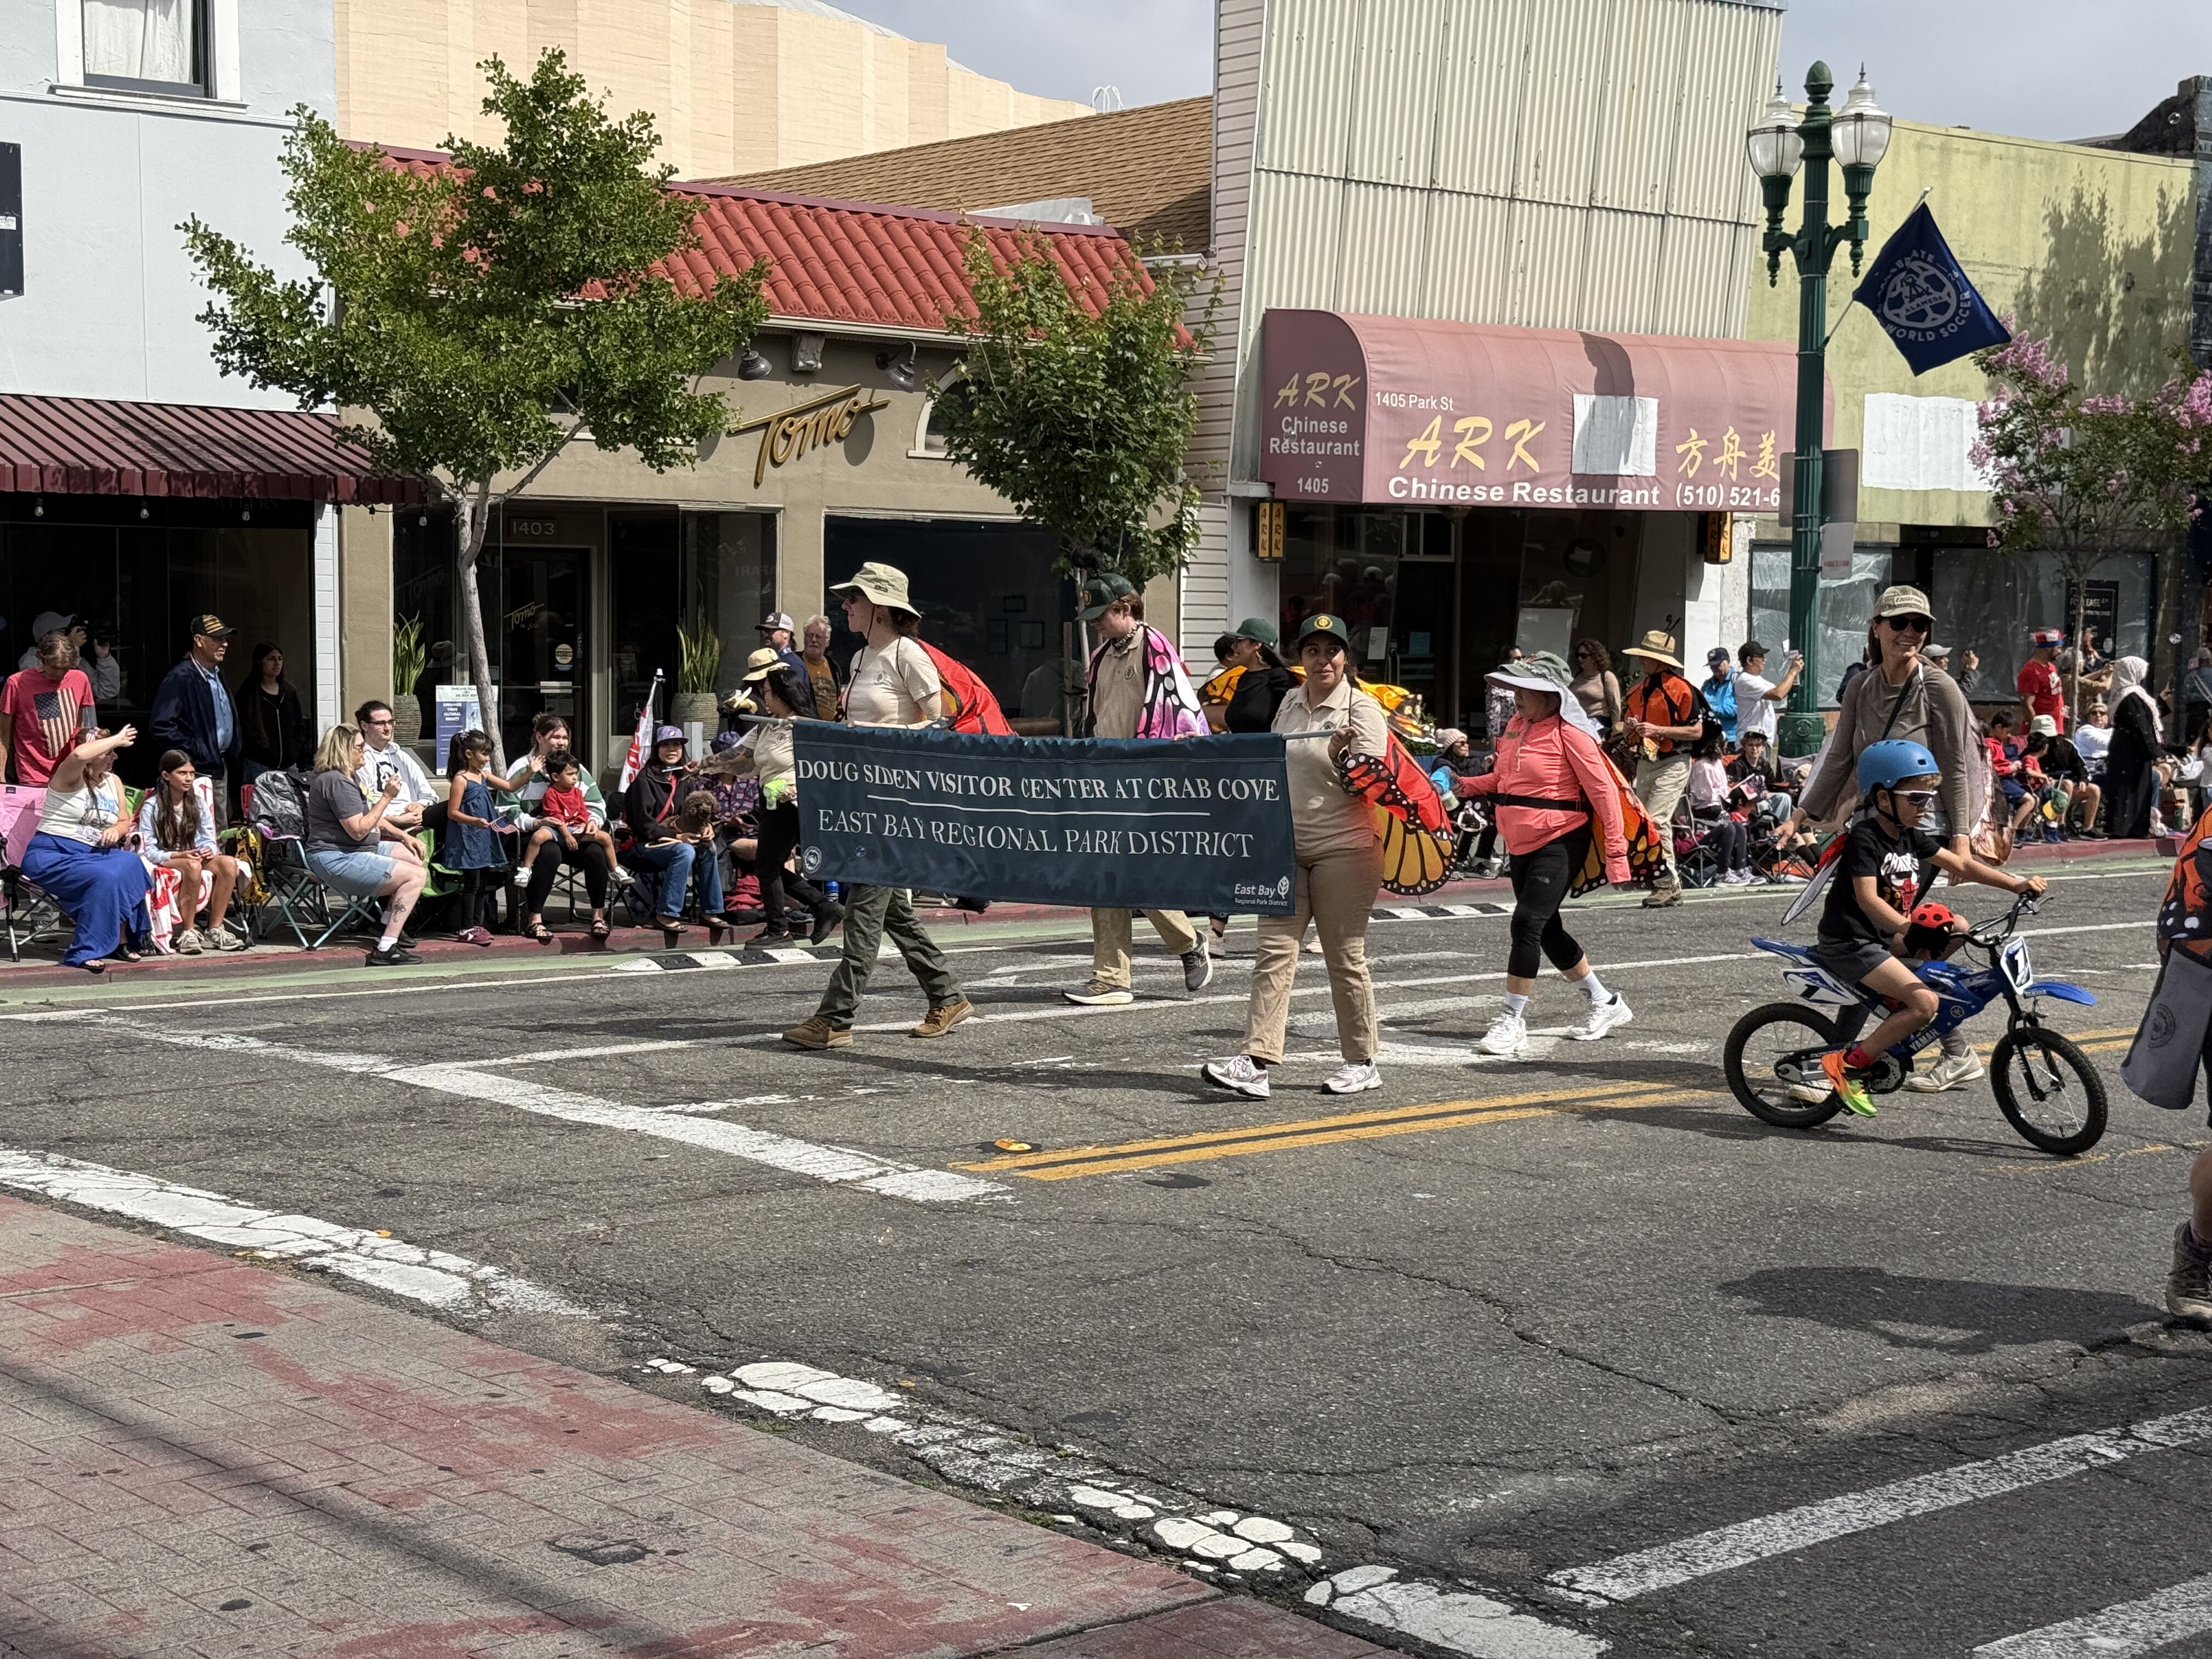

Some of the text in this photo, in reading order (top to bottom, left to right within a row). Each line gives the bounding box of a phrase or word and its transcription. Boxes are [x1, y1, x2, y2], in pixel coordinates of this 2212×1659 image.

[1885, 290, 1971, 342] WORLD SOCCER
[1905, 295, 1944, 314] ALAMEDA
[1273, 372, 1361, 411] ARK
[1375, 391, 1454, 411] 1405 Park St
[729, 383, 891, 484] Tomo
[1281, 416, 1348, 434] Chinese
[1269, 437, 1360, 456] Restaurant
[1398, 414, 1546, 473] ARK
[1296, 477, 1330, 494] 1405
[1389, 476, 1504, 501] Chinese
[1512, 481, 1660, 506] Restaurant
[1675, 482, 1724, 508] (510)
[513, 521, 555, 535] 1403
[1274, 508, 1282, 551] ARK
[503, 601, 545, 630] Tomo
[797, 759, 1280, 801] DOUG SIDEN VISITOR CENTER AT CRAB COVE
[818, 809, 1255, 857] EAST BAY REGIONAL PARK DISTRICT
[1234, 883, 1276, 898] East Bay
[1909, 1028, 1941, 1052] YAMAH
